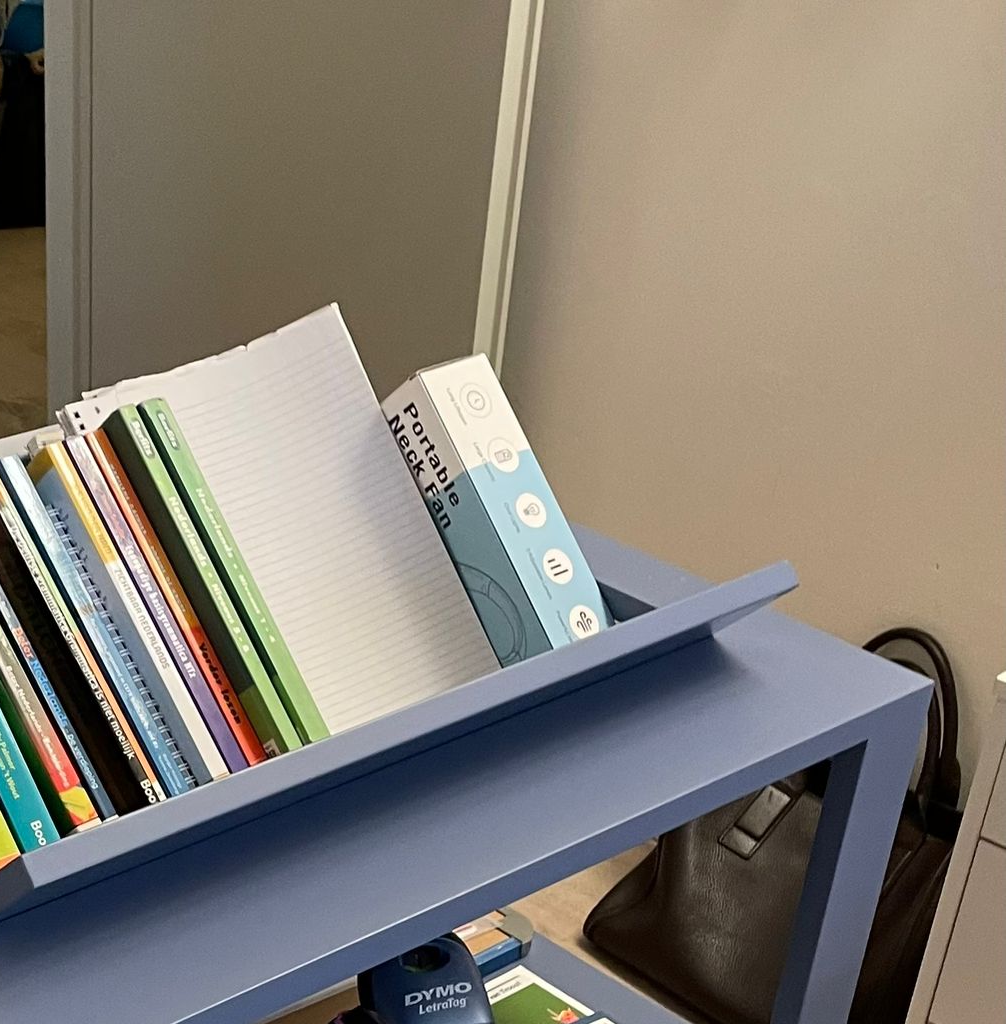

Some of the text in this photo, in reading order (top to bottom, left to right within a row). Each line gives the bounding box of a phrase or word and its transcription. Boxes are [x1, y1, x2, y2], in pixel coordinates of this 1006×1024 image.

[389, 414, 451, 530] Neck Fan
[403, 401, 460, 508] Portable
[168, 494, 209, 567] Nederlands
[195, 486, 235, 558] Nederlands
[137, 614, 170, 670] NEDERLANDS
[12, 625, 35, 659] Beter
[29, 658, 70, 728] Nederlands
[71, 745, 99, 790] verdieping
[17, 688, 44, 733] Nederlands
[94, 688, 105, 701] is
[99, 698, 116, 721] niet
[108, 719, 137, 761] moeilijk
[139, 777, 159, 805] Boo
[28, 818, 50, 846] Boo
[404, 982, 472, 1006] DYMO
[419, 998, 467, 1015] LetraTag
